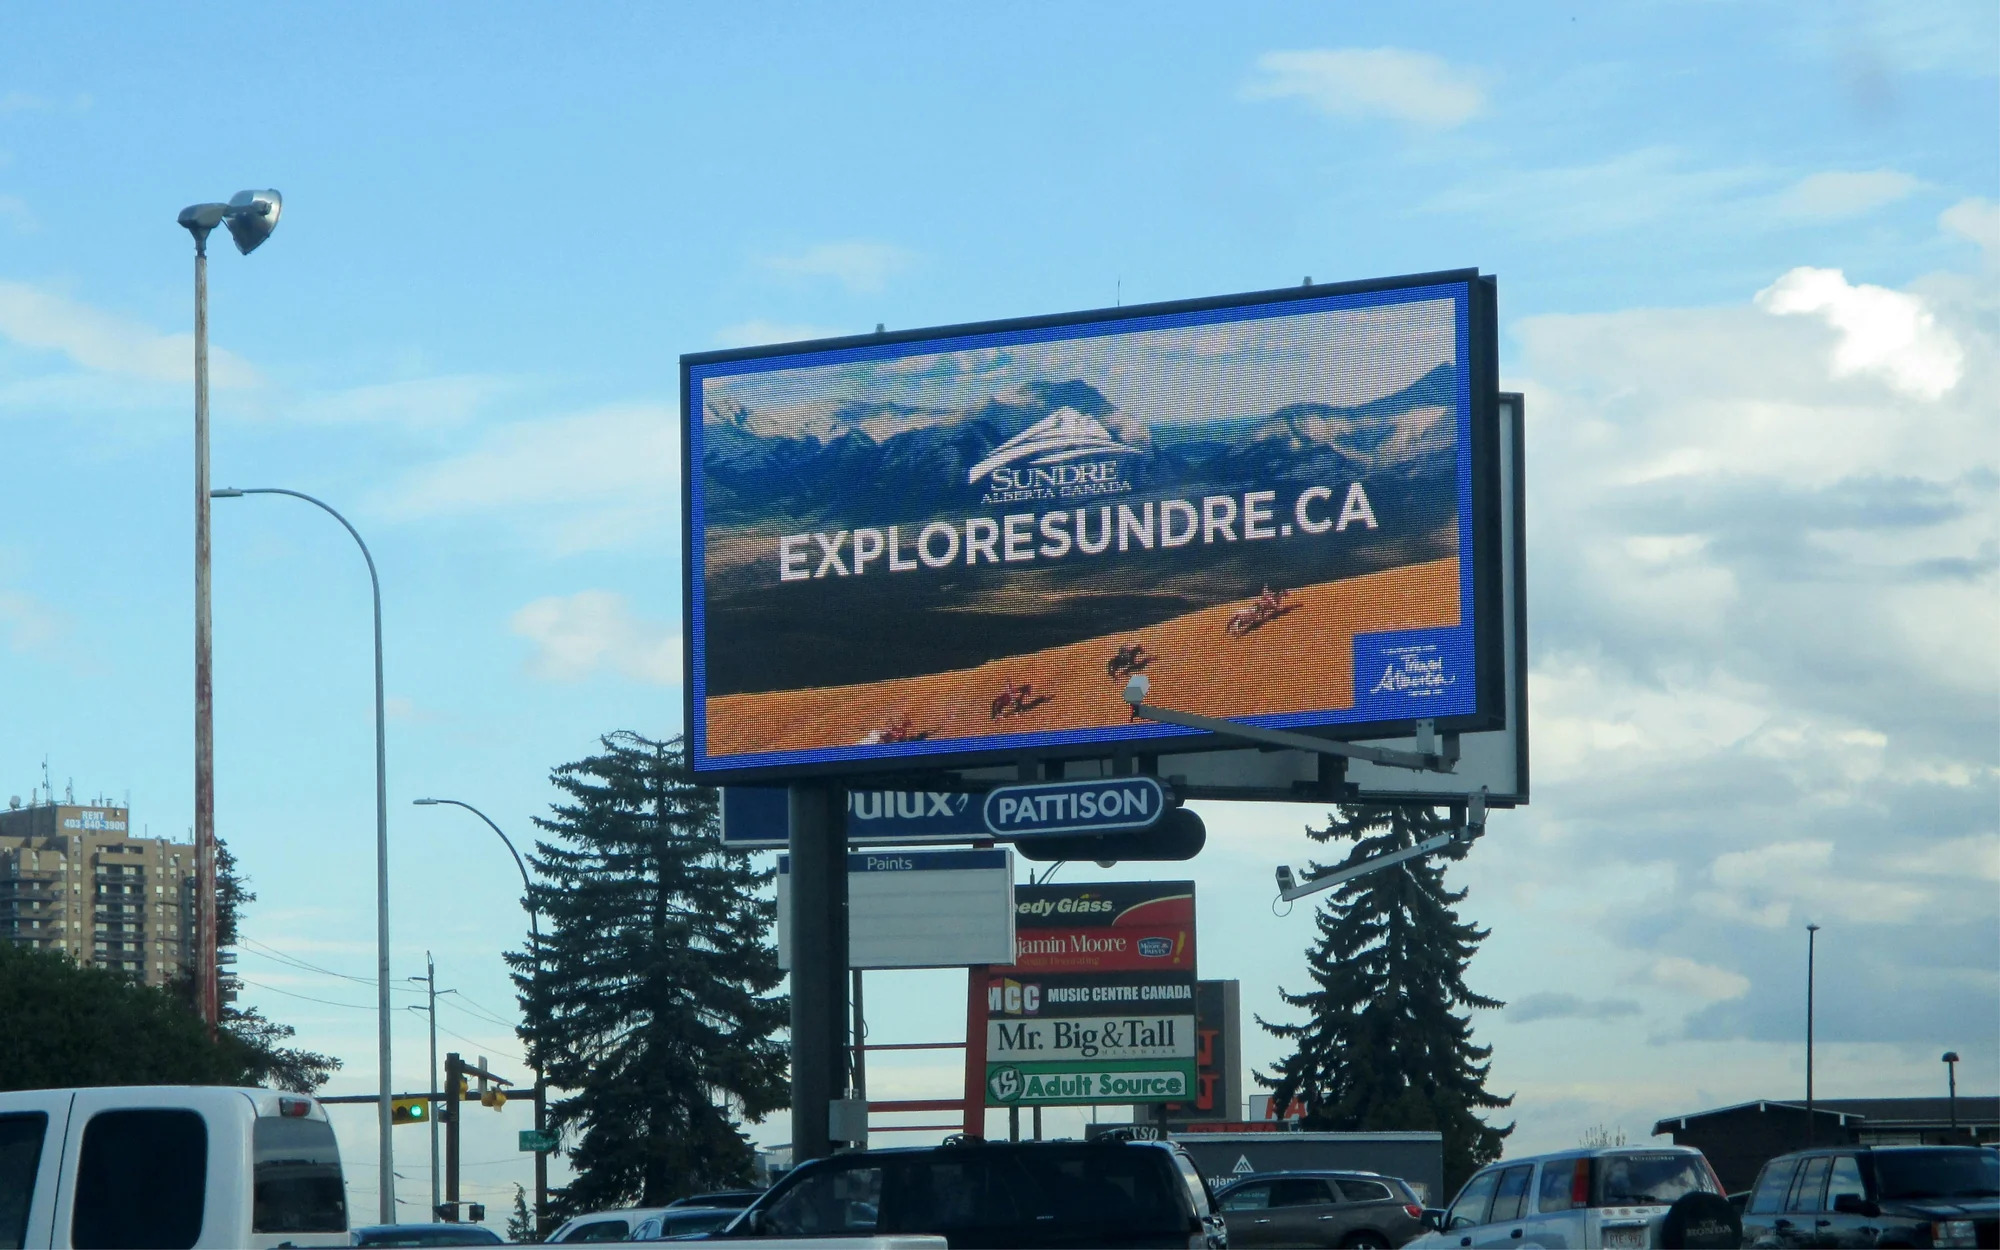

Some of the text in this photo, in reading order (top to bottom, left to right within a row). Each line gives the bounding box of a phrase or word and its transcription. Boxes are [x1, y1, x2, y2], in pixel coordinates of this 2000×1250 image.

[991, 460, 1117, 490] SUNDRE
[981, 480, 1131, 503] ALBERTA CANADA
[780, 482, 1379, 582] EXPLORESUNDRE.CA
[82, 810, 104, 820] RENT
[847, 790, 954, 820] ulux
[1000, 788, 1148, 823] PATTISON
[867, 857, 913, 871] Paints
[1057, 898, 1113, 913] Glass
[1070, 934, 1127, 953] Moore
[1048, 987, 1090, 1002] MUSIC
[1092, 986, 1139, 1001] CENTRE
[1141, 985, 1192, 1000] CANADA
[997, 1022, 1044, 1051] Mr.
[1025, 1075, 1092, 1097] Adult
[1098, 1074, 1182, 1096] Source
[1686, 1224, 1733, 1237] HONDA
